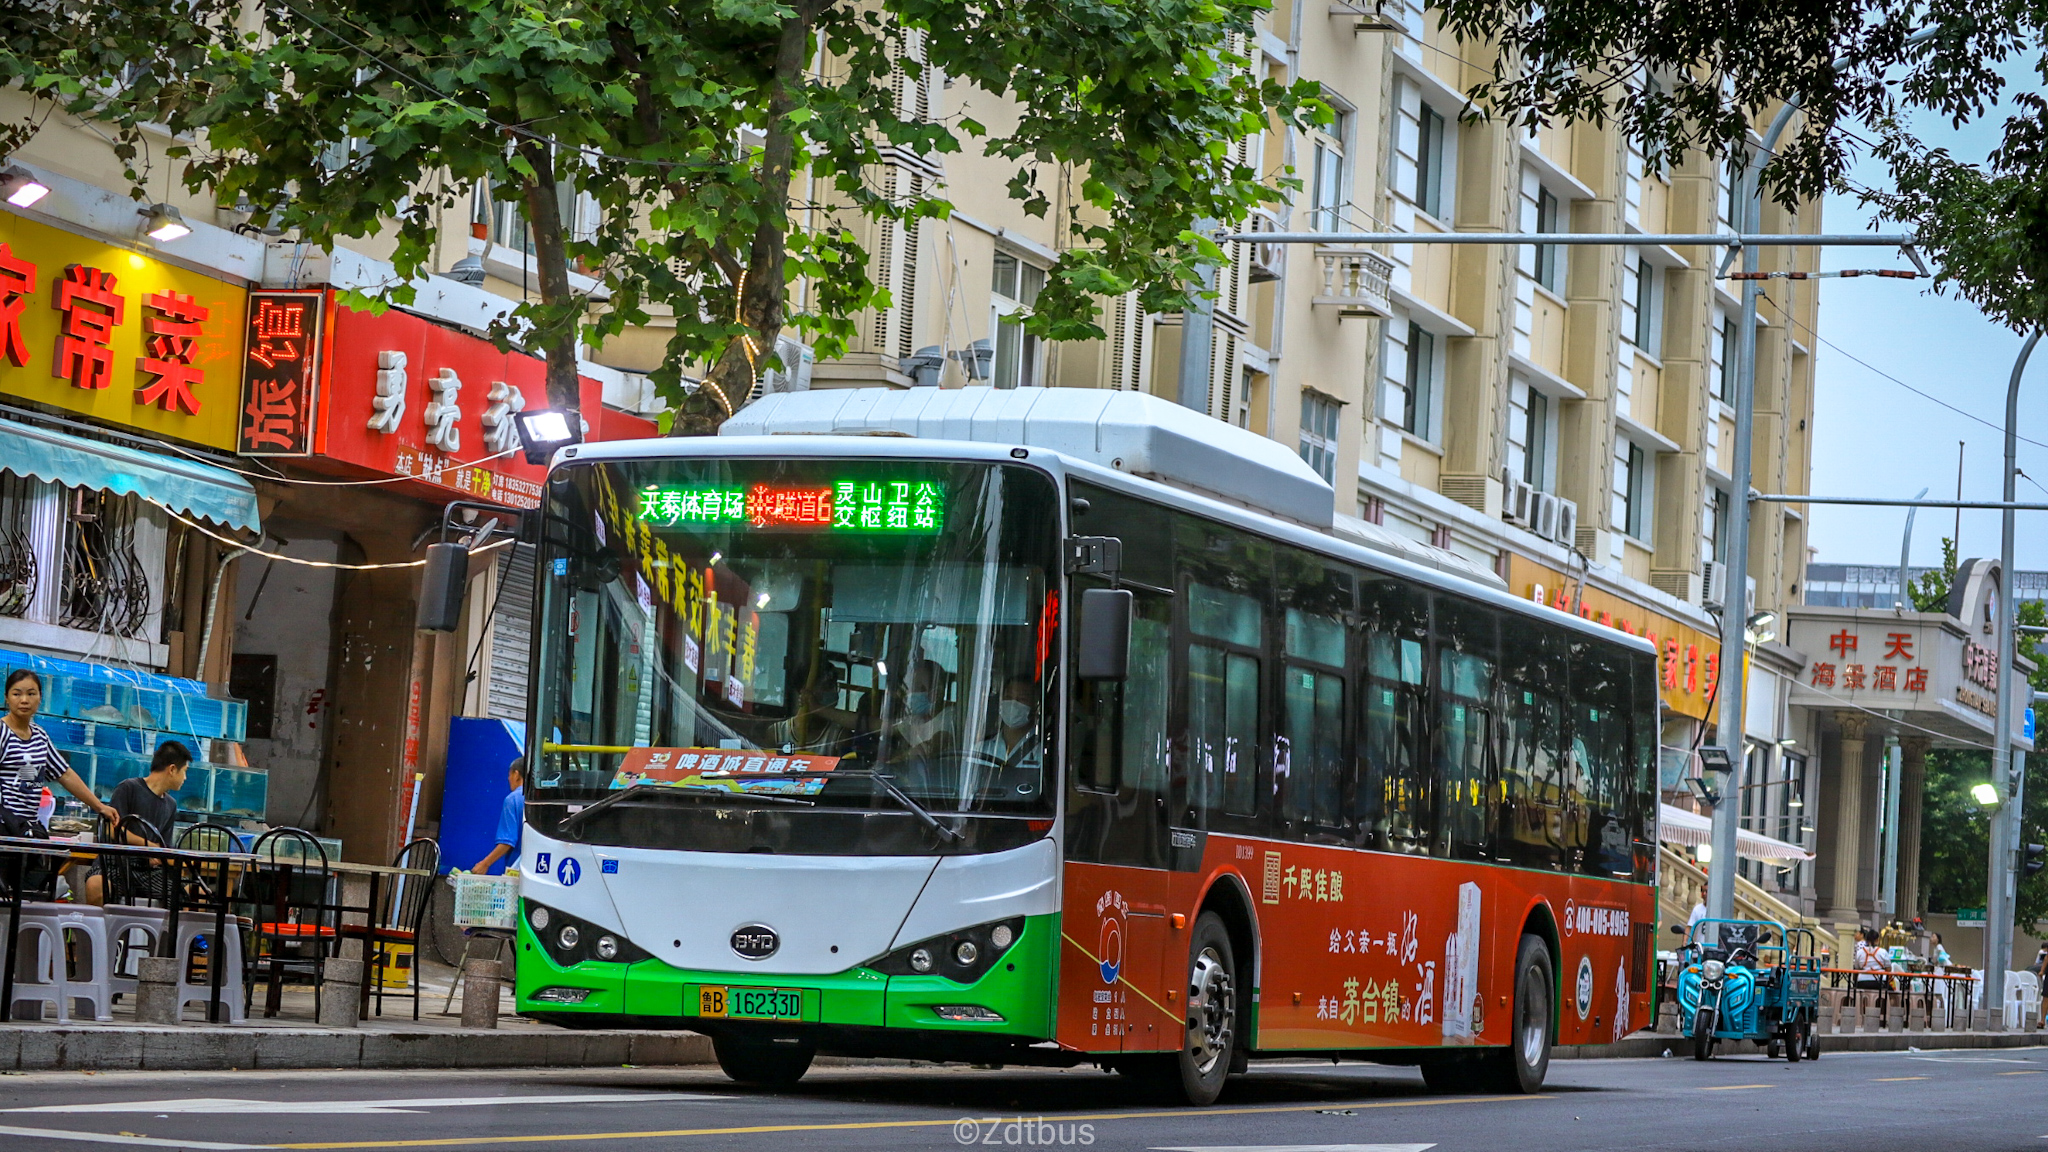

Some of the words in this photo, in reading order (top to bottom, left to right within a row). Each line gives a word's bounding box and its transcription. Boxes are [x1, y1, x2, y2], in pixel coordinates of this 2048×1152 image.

[245, 299, 304, 450] 旅馆
[367, 350, 589, 458] 勇亮旅
[396, 452, 413, 476] 本店
[456, 469, 472, 490] 就是
[472, 468, 491, 496] 干净
[639, 490, 745, 520] 天泰体育场
[836, 483, 936, 505] 灵山卫公
[834, 506, 936, 528] 交枢纽站
[1830, 628, 1914, 660] 中天
[1811, 662, 1928, 692] 海景酒店
[675, 753, 811, 774] 啤酒城直通车
[1283, 864, 1344, 903] 千熙佳酿
[735, 934, 774, 949] BYD
[702, 991, 724, 1014] 鲁B
[734, 992, 800, 1016] 16233D
[1317, 976, 1411, 1026] 来自茅台镇的
